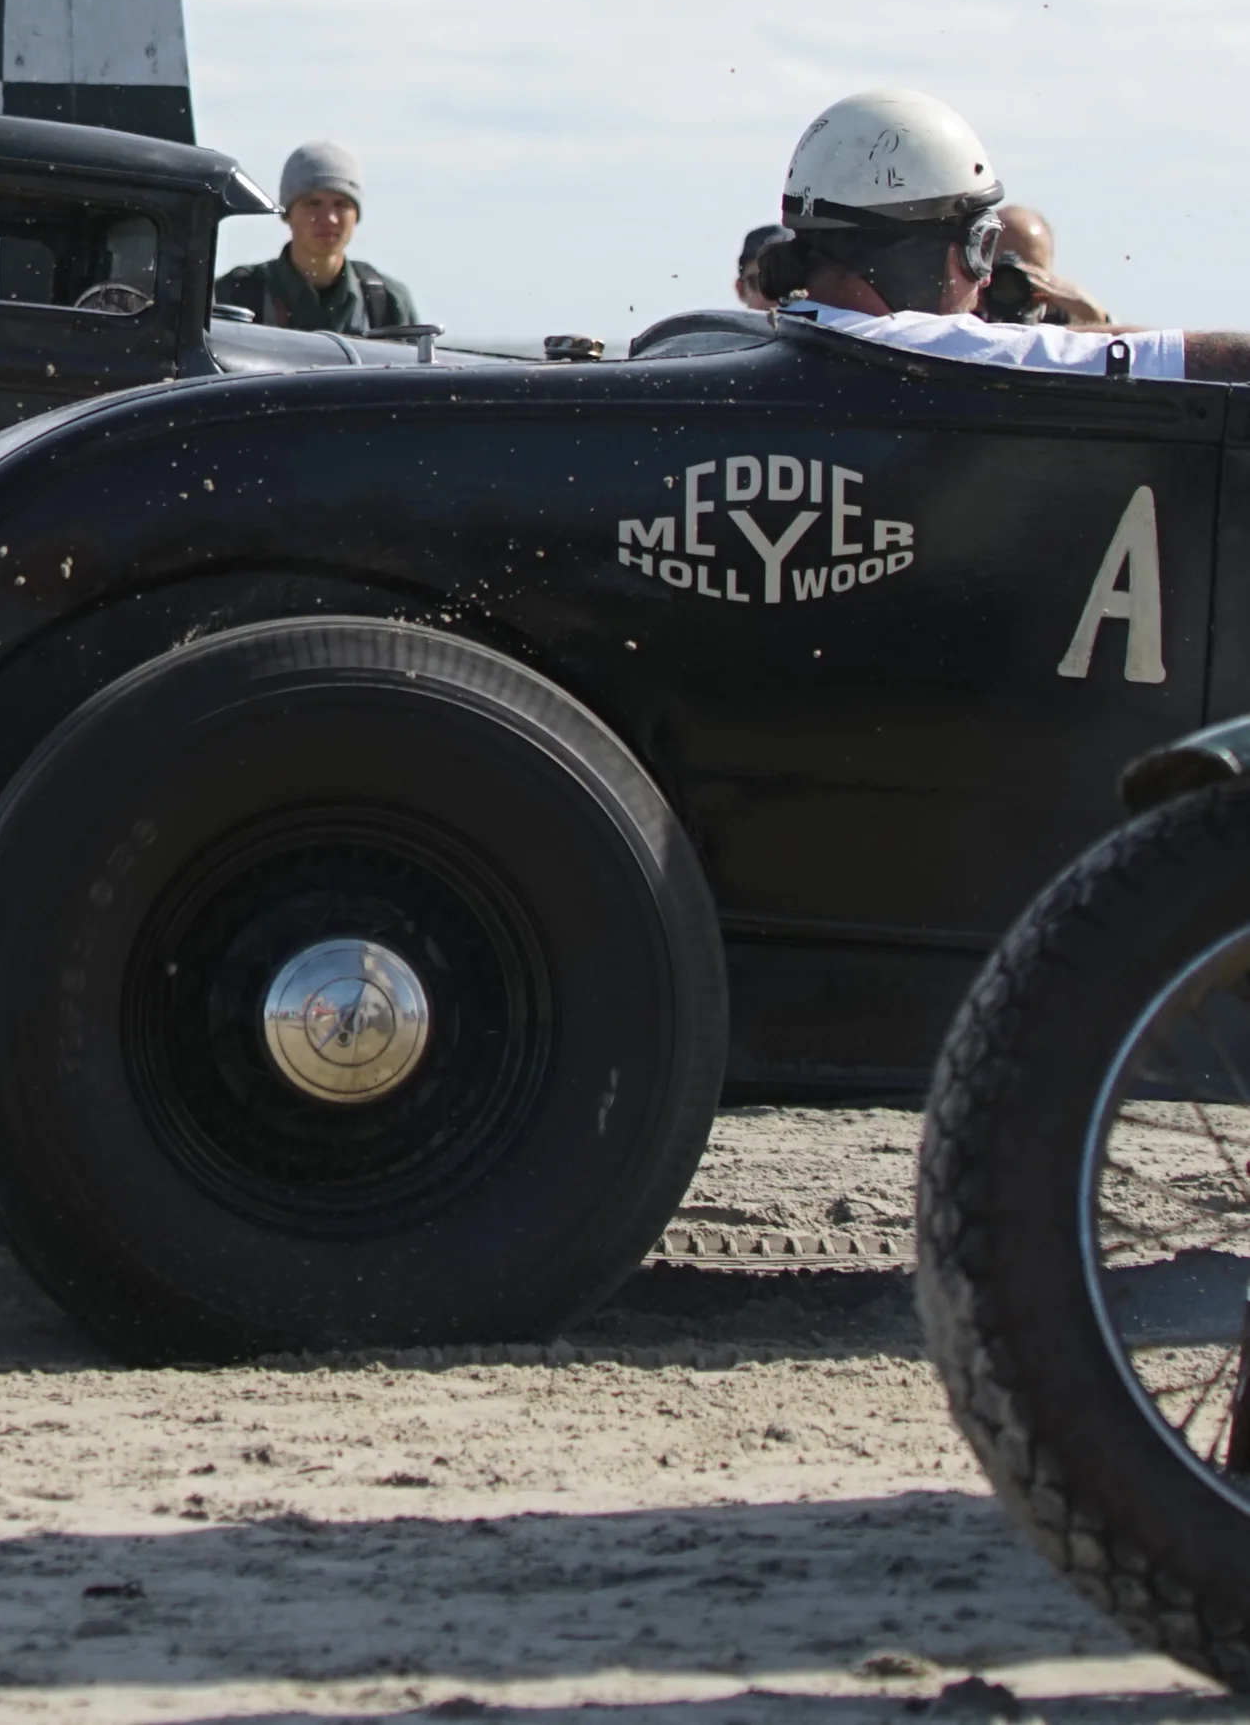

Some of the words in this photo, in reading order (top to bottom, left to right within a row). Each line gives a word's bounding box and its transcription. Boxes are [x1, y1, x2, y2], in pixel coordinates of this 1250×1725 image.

[618, 461, 914, 604] MEYER
[618, 510, 914, 604] HOLLYWOOD
[685, 454, 864, 557] EDDIE
[1057, 485, 1167, 684] A
